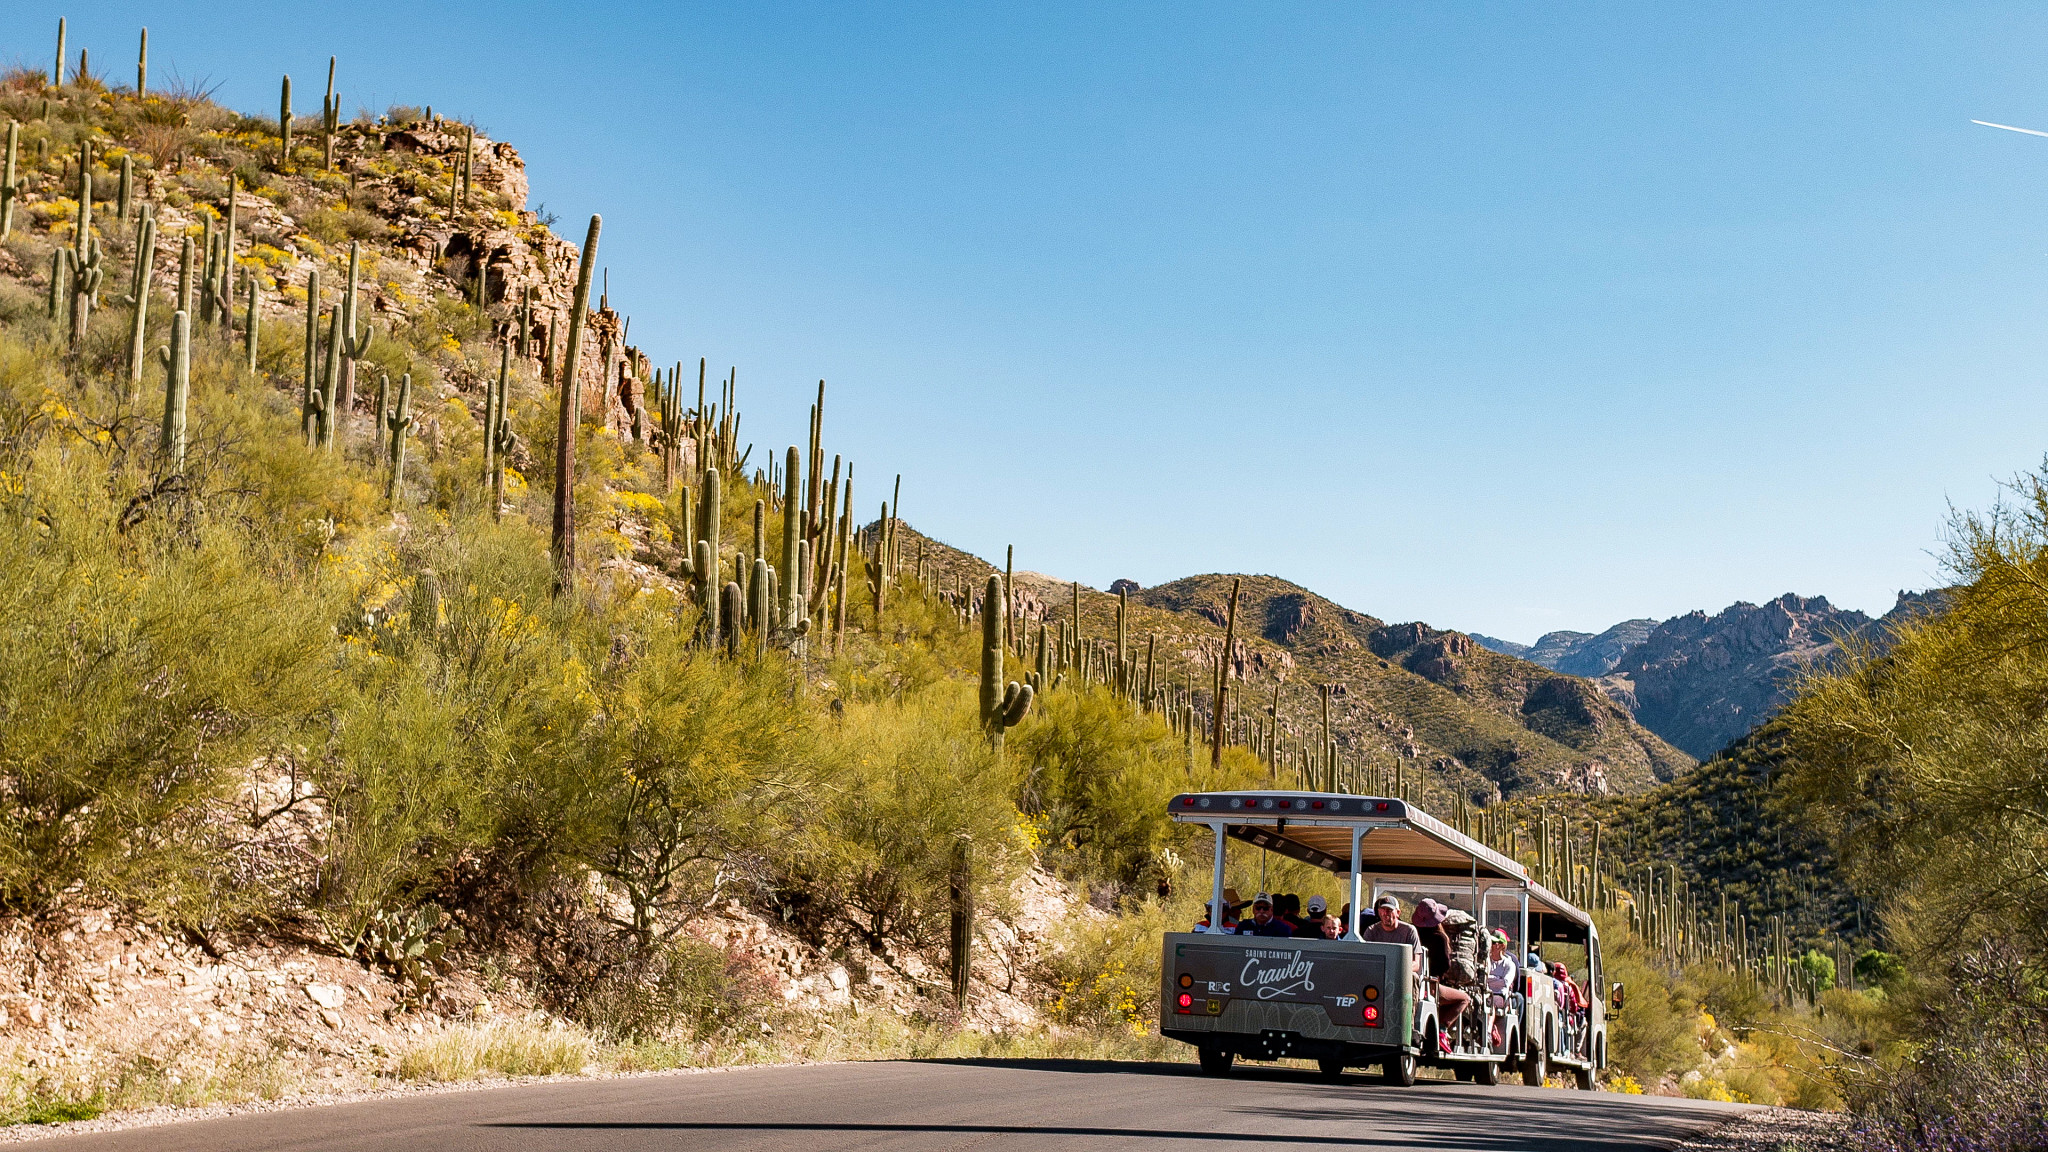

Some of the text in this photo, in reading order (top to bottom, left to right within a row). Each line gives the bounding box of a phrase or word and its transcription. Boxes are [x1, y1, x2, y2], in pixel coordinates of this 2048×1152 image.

[1245, 950, 1292, 960] SABINO CANYON
[1240, 950, 1315, 991] Crawler
[1335, 996, 1356, 1007] TEP
